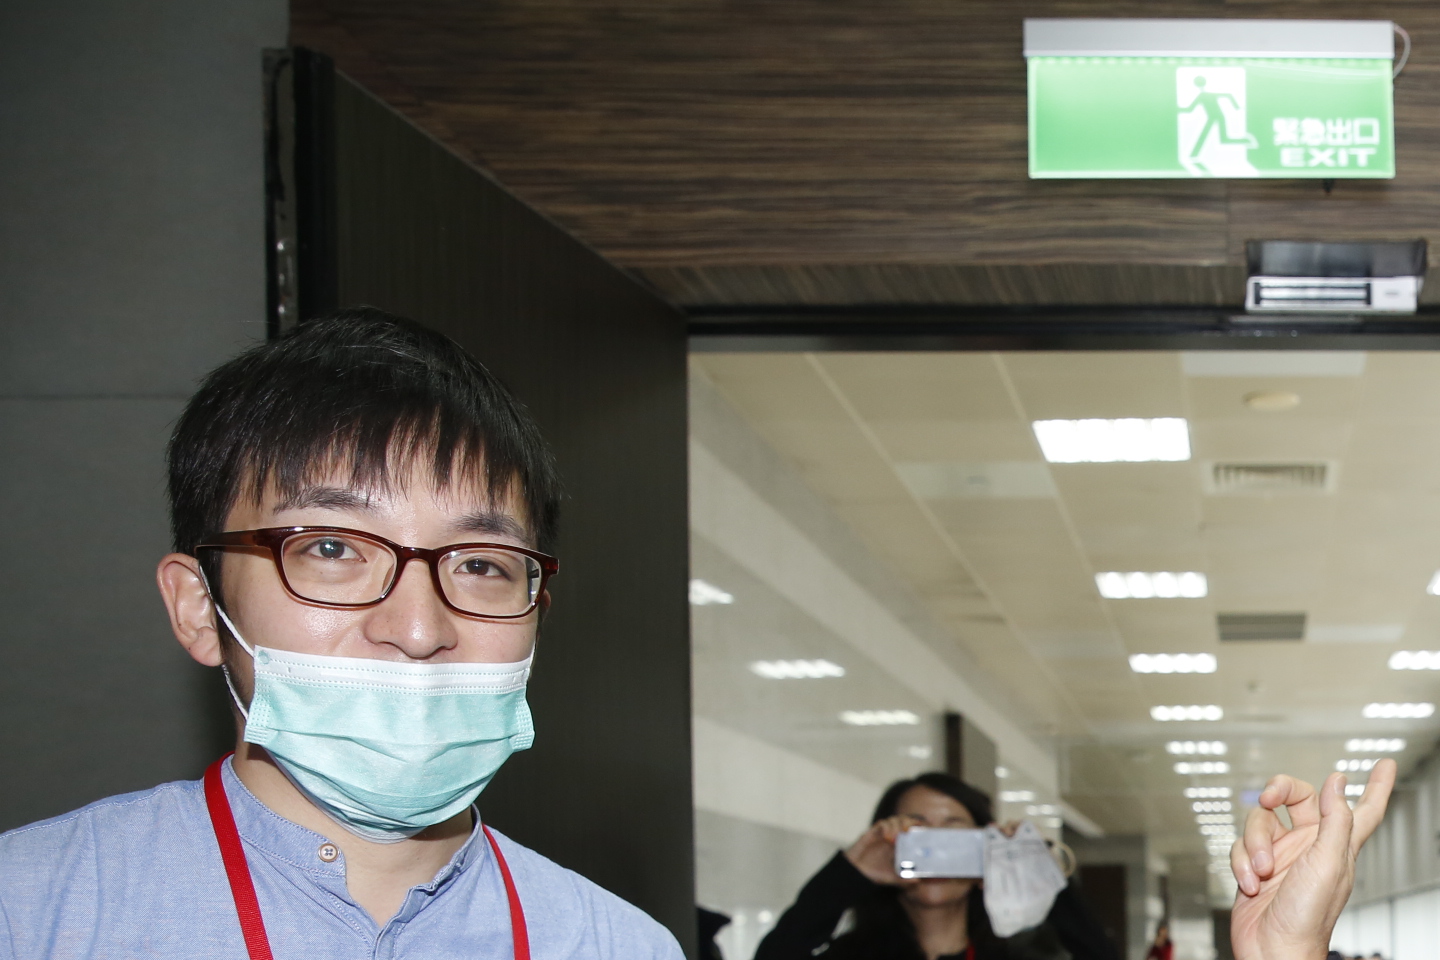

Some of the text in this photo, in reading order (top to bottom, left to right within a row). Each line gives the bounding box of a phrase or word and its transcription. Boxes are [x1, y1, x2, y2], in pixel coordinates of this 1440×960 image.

[1272, 117, 1380, 146] 緊急出口
[1280, 147, 1377, 167] EXIT
